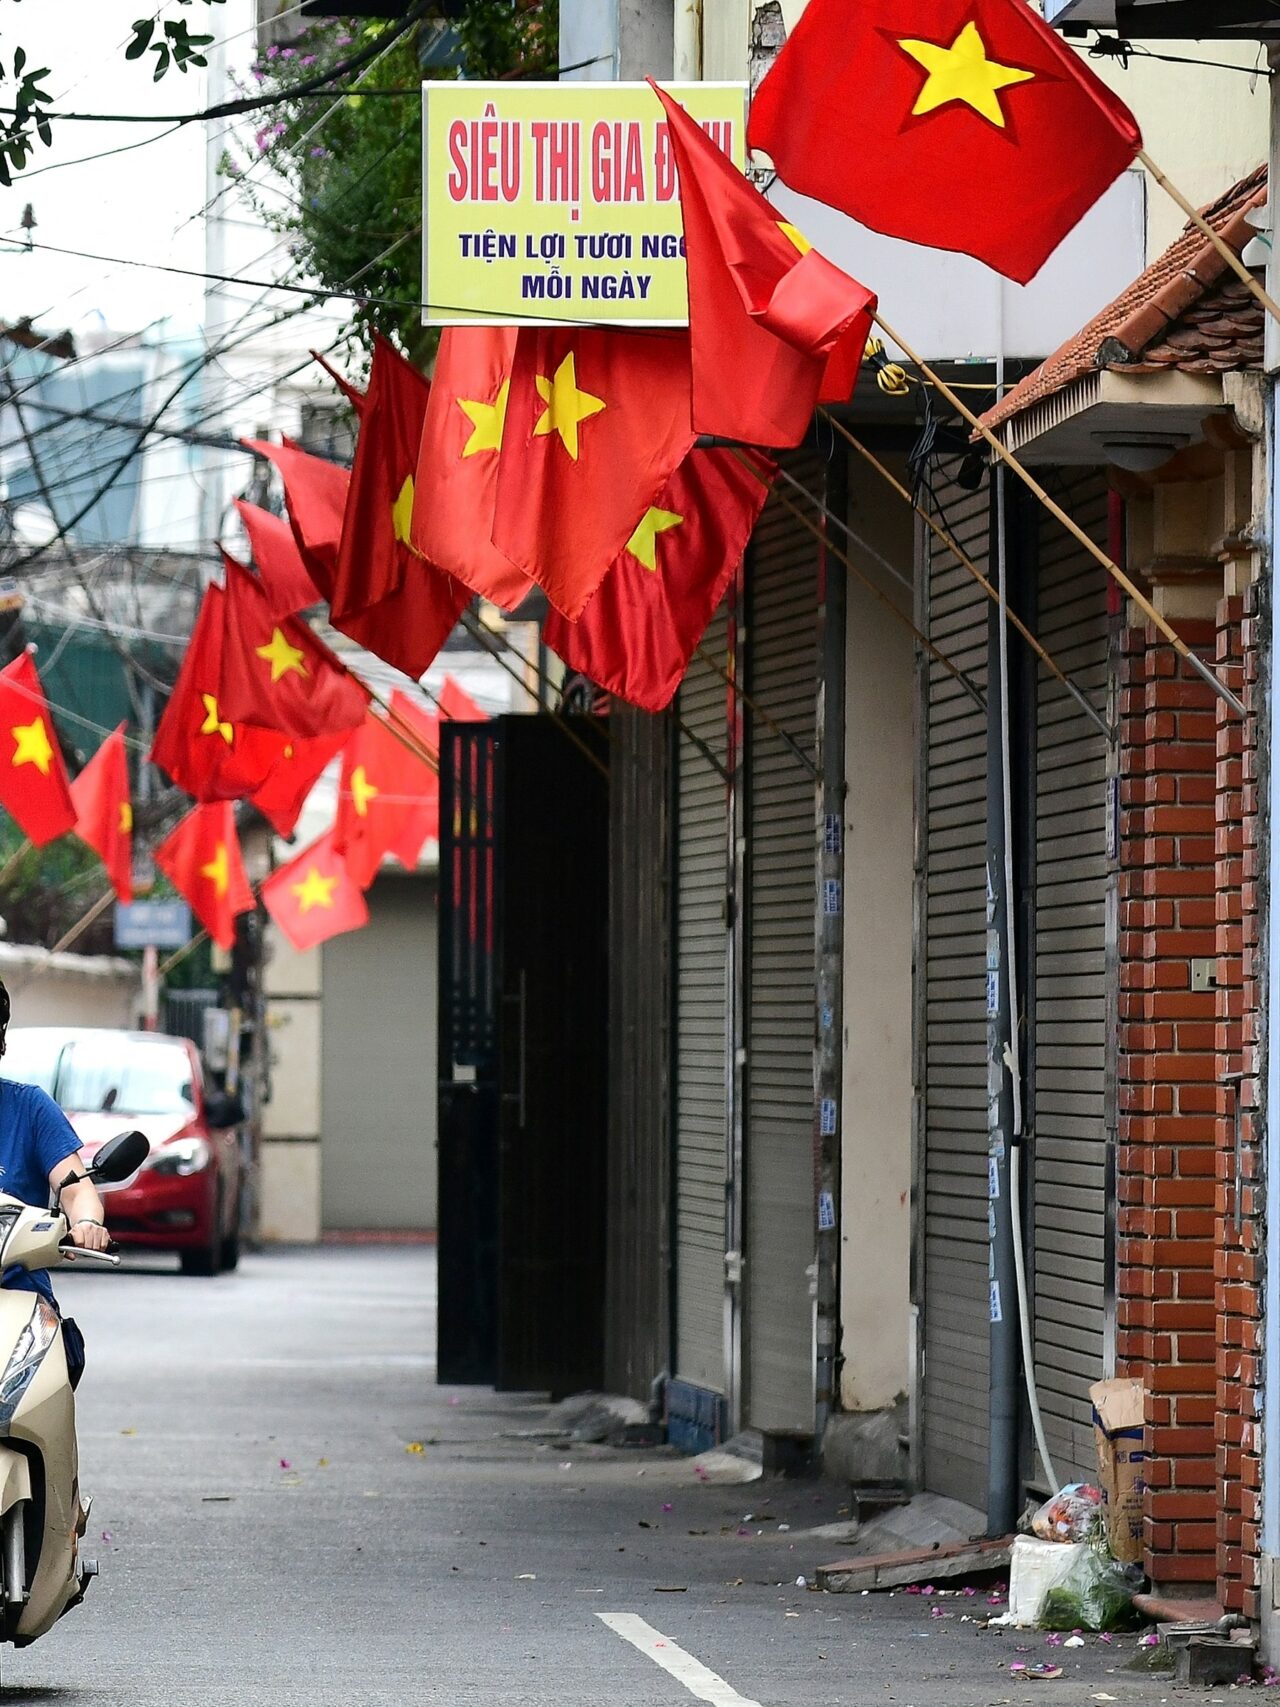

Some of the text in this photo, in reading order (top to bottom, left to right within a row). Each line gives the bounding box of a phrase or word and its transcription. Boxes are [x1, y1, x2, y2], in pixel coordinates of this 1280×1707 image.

[449, 103, 520, 202] SIÊU
[531, 122, 579, 221] THỊ
[592, 121, 645, 203] GIA
[458, 229, 516, 263] TIỆN
[526, 233, 565, 264] LỢI
[574, 233, 632, 258] TƯƠI
[522, 266, 651, 299] MỖI NGÀY
